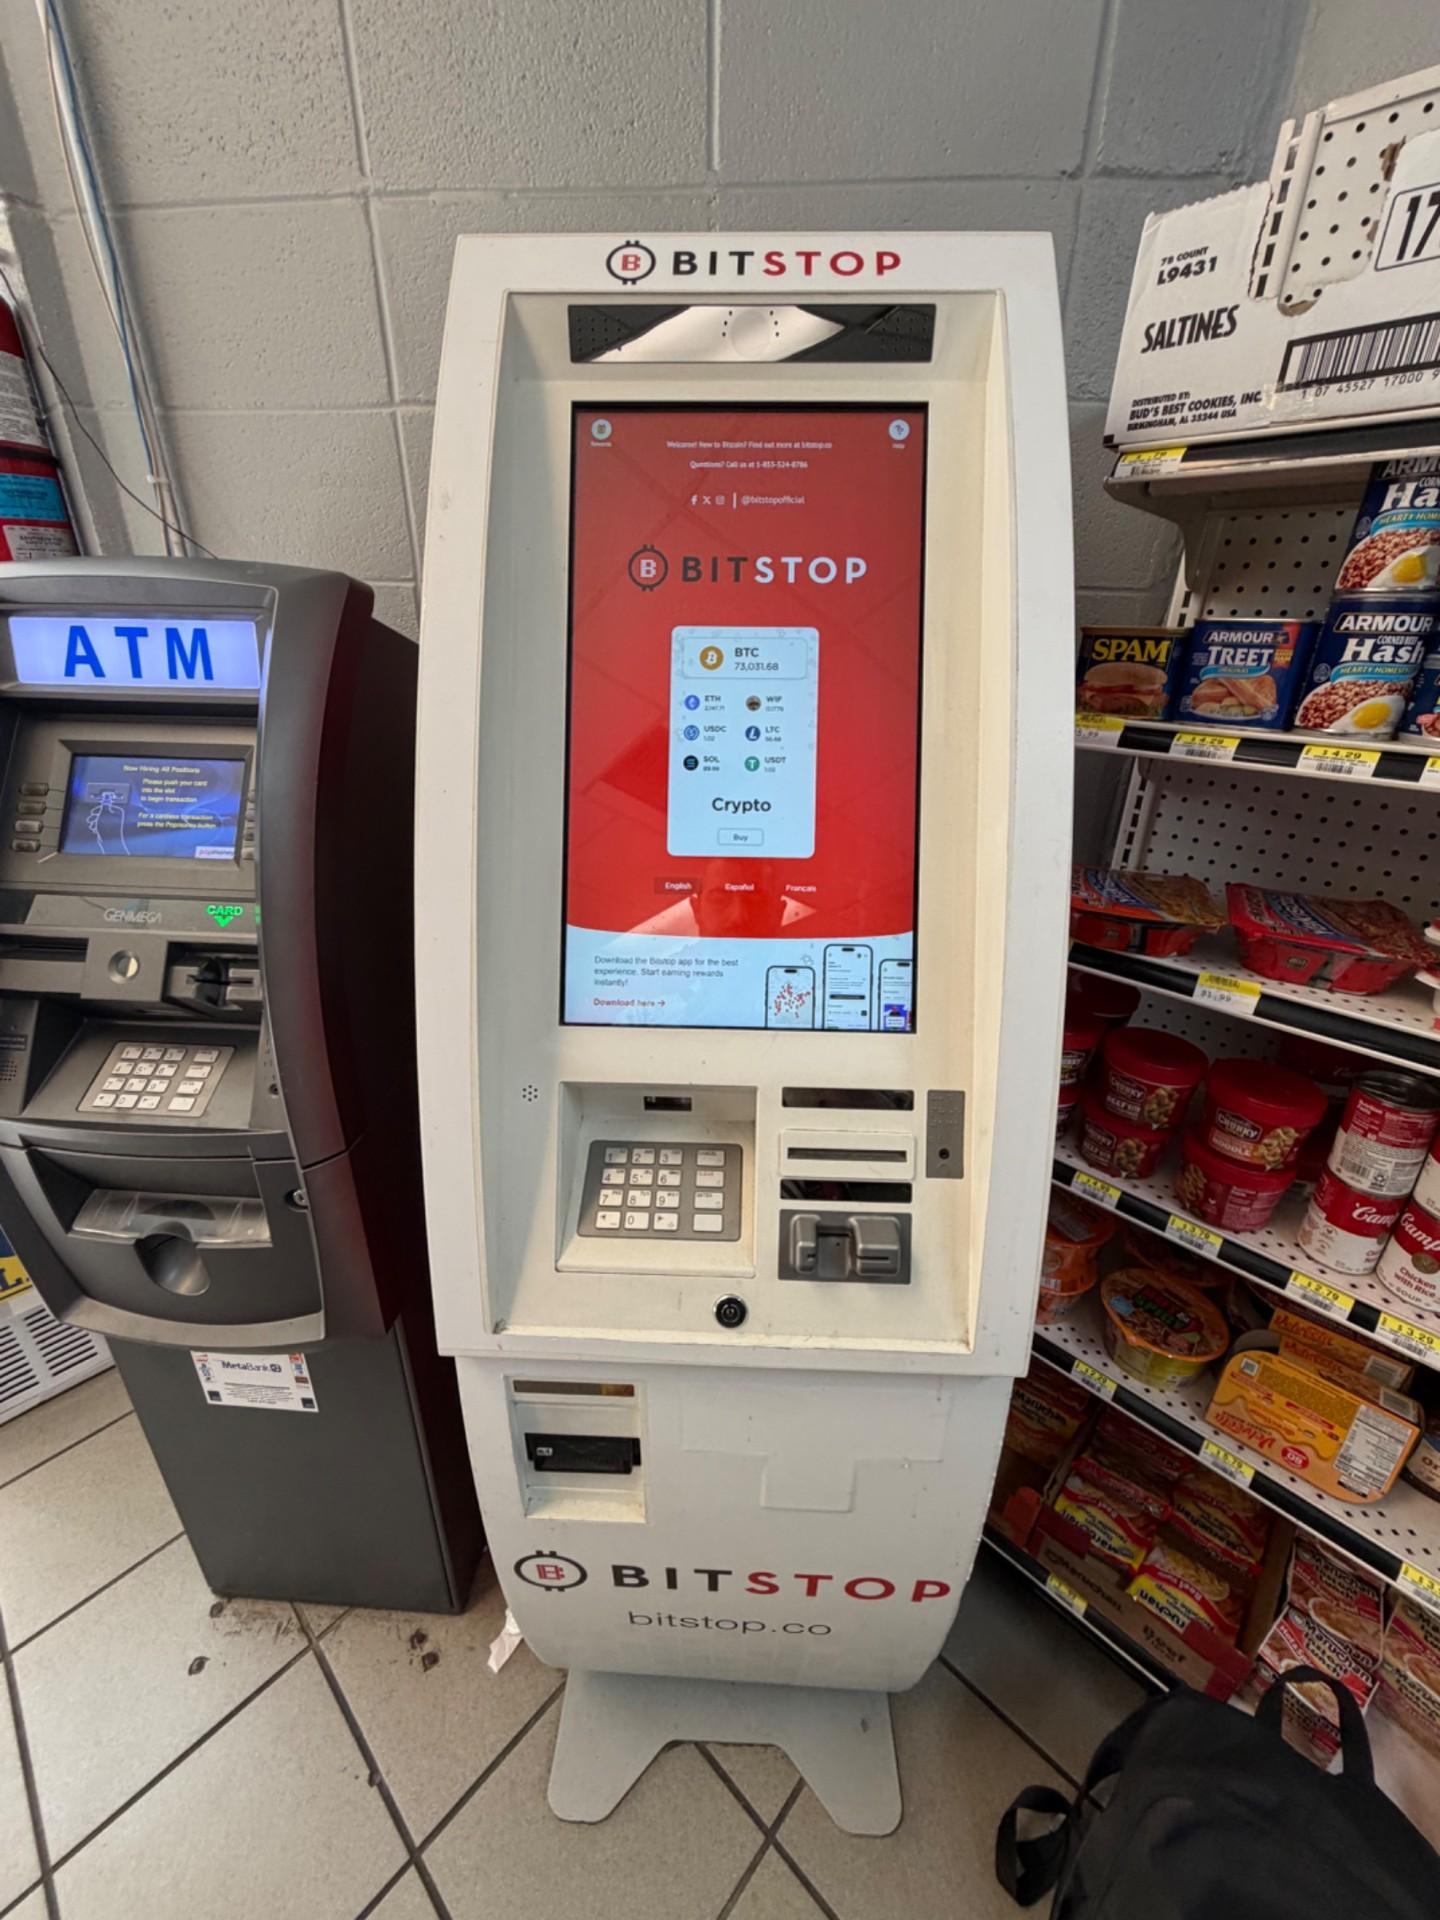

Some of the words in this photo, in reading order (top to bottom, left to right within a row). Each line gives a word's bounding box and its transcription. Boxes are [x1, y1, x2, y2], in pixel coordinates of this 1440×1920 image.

[1176, 246, 1209, 262] COUNT
[672, 250, 902, 277] BITSTOP
[1157, 256, 1218, 285] L9431
[1140, 304, 1240, 353] SALTINES
[1336, 379, 1376, 393] 45527
[1384, 371, 1424, 387] 17000
[1129, 407, 1160, 421] BUD'S
[1161, 403, 1186, 416] BEST
[1187, 395, 1237, 413] COOKIES,
[1131, 393, 1177, 408] DISTRIBUTED
[1220, 409, 1237, 419] USA
[681, 556, 867, 584] BITSTOP
[1339, 614, 1434, 633] ARMOUR
[1208, 631, 1274, 643] ARMOUR
[64, 625, 215, 681] ATM
[733, 647, 760, 658] BTC
[1091, 638, 1172, 663] SPAM
[1207, 645, 1274, 666] TREET
[1340, 638, 1425, 664] Hash
[703, 725, 727, 733] USDC
[703, 755, 720, 763] SOL
[711, 797, 772, 814] Crypto
[733, 833, 749, 842] Buy
[664, 881, 692, 890] English
[103, 909, 163, 924] GENMEGA
[206, 904, 243, 917] CARD
[593, 955, 633, 964] Download
[635, 956, 648, 964] the
[677, 959, 694, 967] app
[695, 958, 706, 966] for
[594, 968, 637, 977] experience.
[640, 968, 660, 976] Start
[661, 969, 691, 978] earning
[593, 998, 635, 1006] Download
[1399, 1266, 1437, 1291] Chicken
[1414, 1283, 1437, 1299] Rice
[221, 1360, 269, 1372] MetaBank
[611, 1564, 952, 1603] BITSTOP
[1140, 1590, 1186, 1629] ruchan
[628, 1611, 833, 1636] bitstop.co
